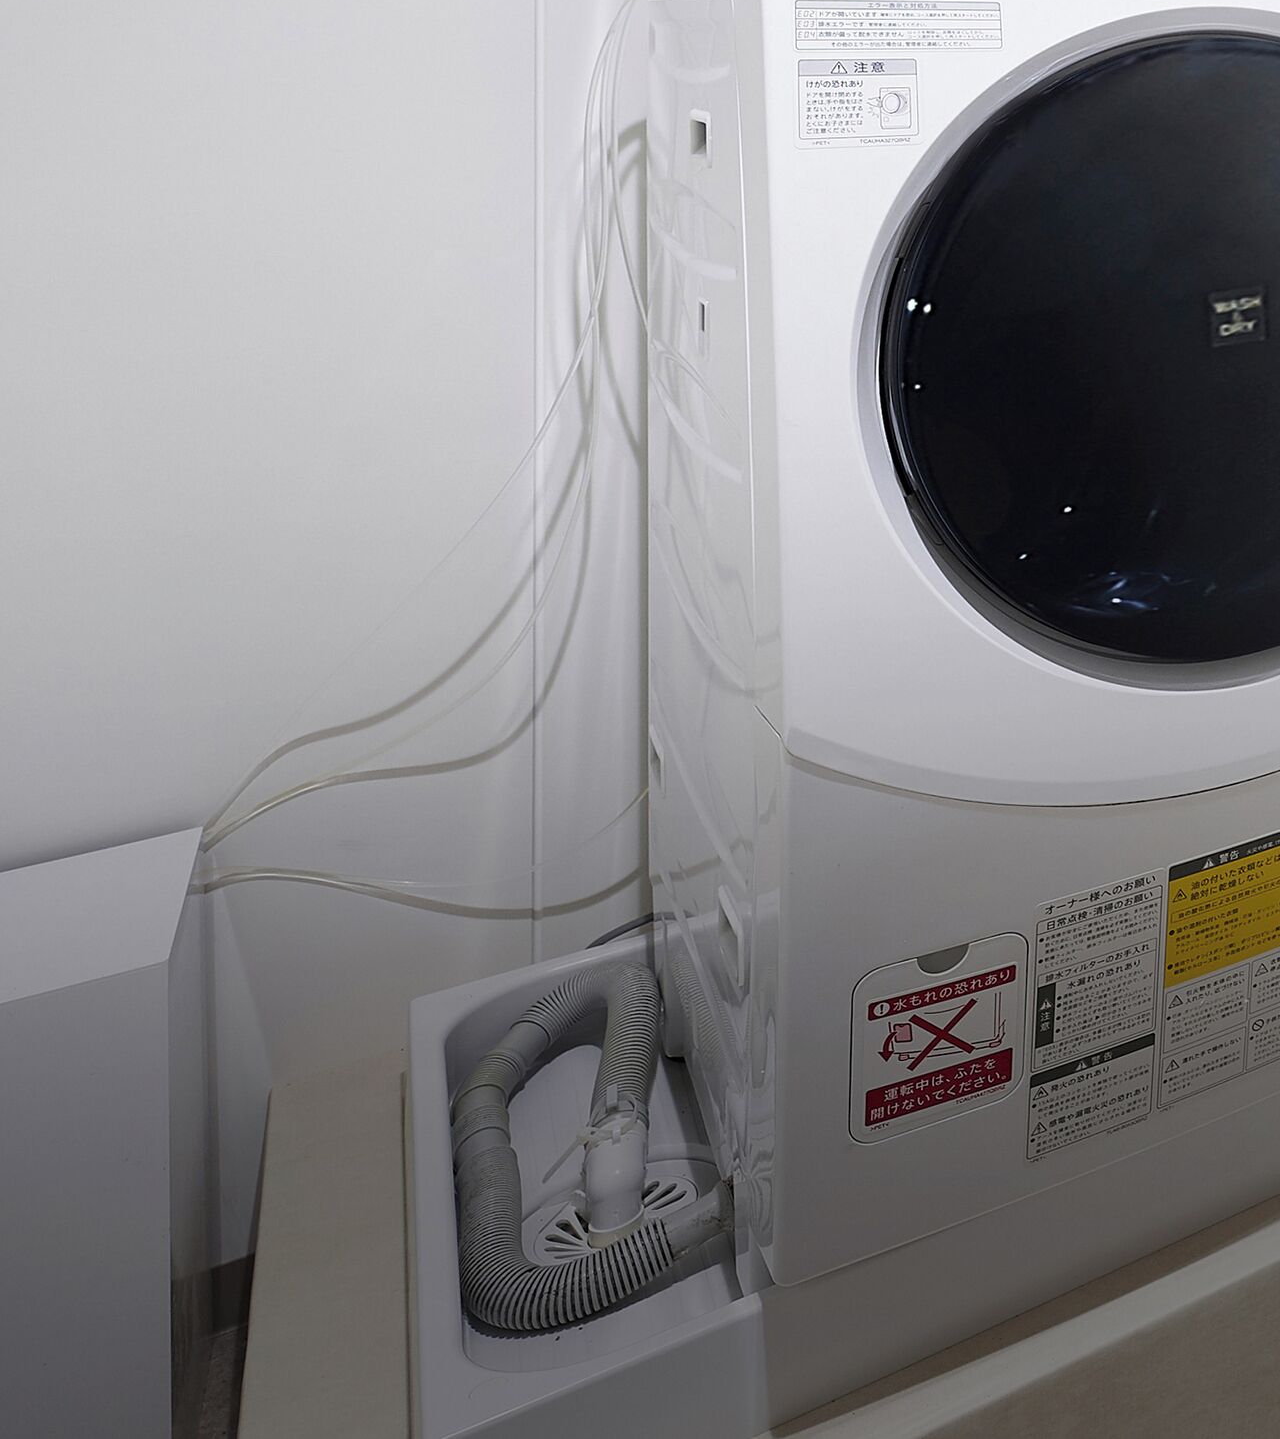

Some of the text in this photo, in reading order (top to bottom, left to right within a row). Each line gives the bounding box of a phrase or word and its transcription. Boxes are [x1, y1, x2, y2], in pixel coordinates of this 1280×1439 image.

[805, 80, 863, 88] けがの恐れあり
[853, 61, 886, 73] 注意
[1045, 875, 1156, 915] オーナー様へのお願い
[893, 969, 1011, 1012] 水もれの恐れあり
[870, 1074, 1007, 1121] 開けないでください。
[884, 1058, 996, 1102] 運転中は、ふたを
